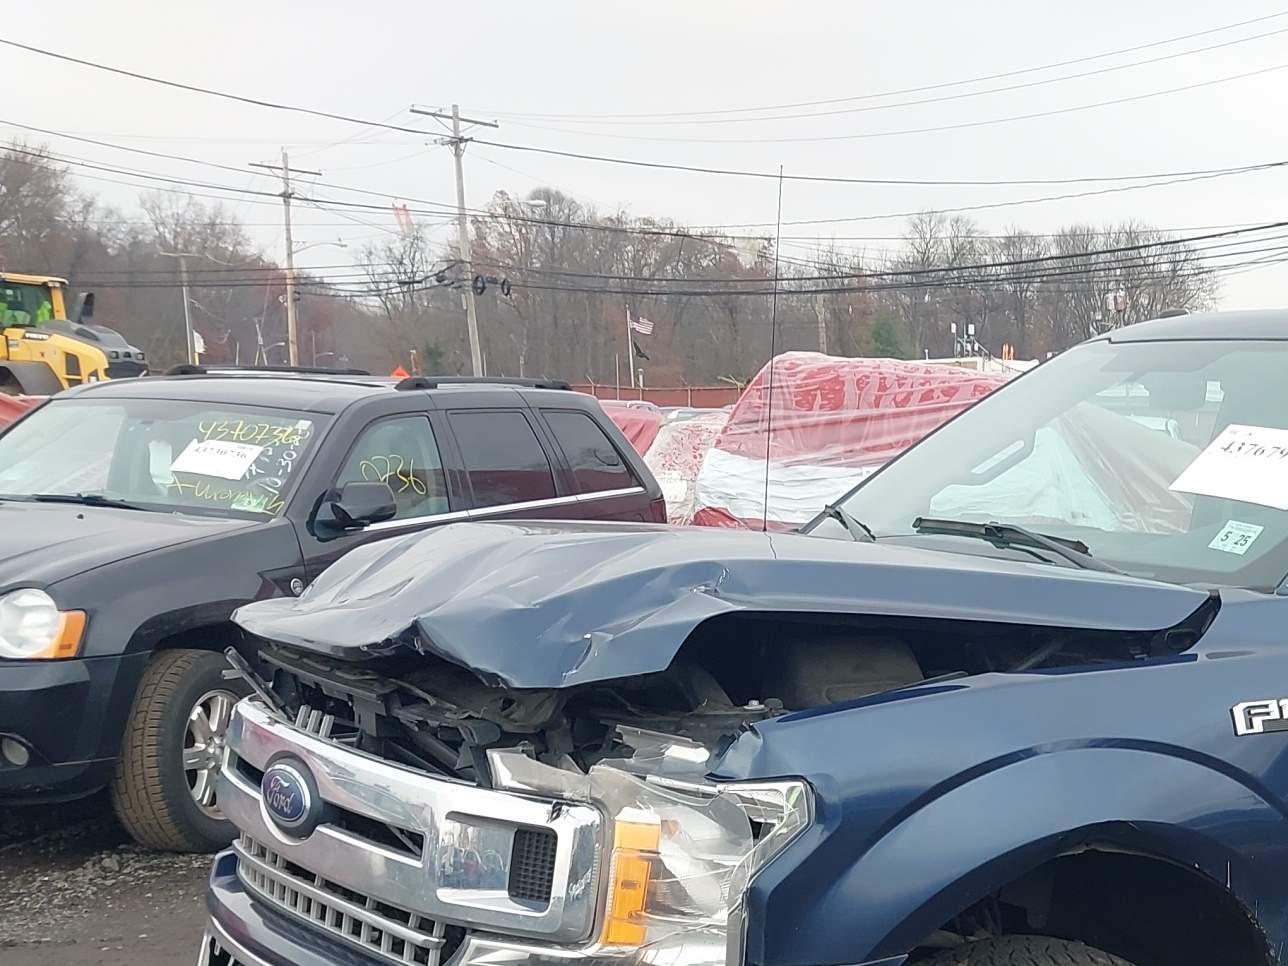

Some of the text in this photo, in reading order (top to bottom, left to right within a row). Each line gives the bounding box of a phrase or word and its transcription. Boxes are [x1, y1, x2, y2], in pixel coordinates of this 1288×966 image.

[1220, 531, 1251, 547] 5 25
[267, 776, 295, 814] Ford
